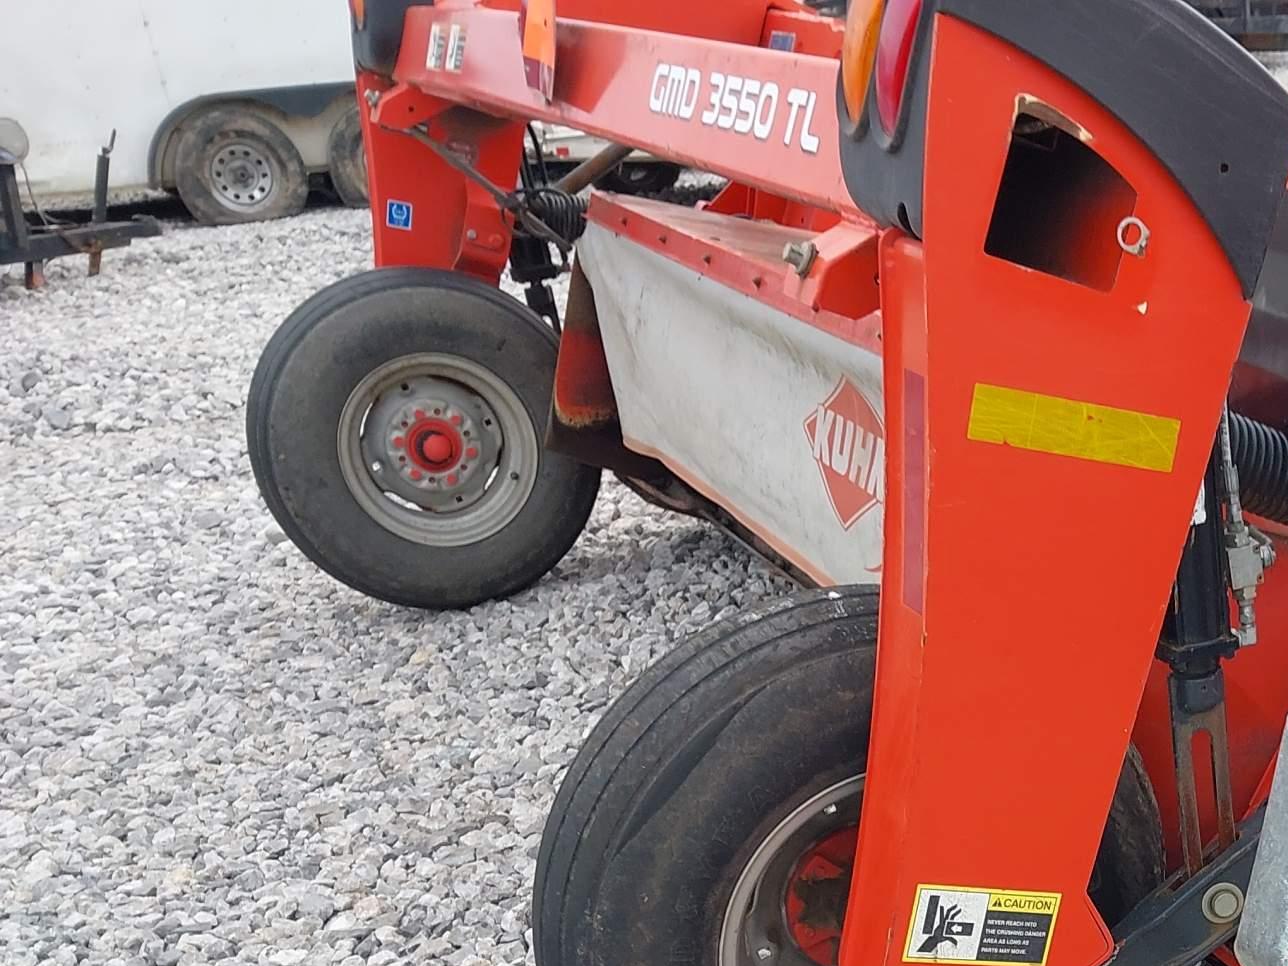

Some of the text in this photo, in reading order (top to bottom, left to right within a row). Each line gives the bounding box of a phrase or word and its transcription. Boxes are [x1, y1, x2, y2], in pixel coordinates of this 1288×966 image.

[649, 63, 820, 153] GMD 3550 TL
[1003, 898, 1052, 911] CAUTION
[996, 929, 1024, 937] CRUSHING
